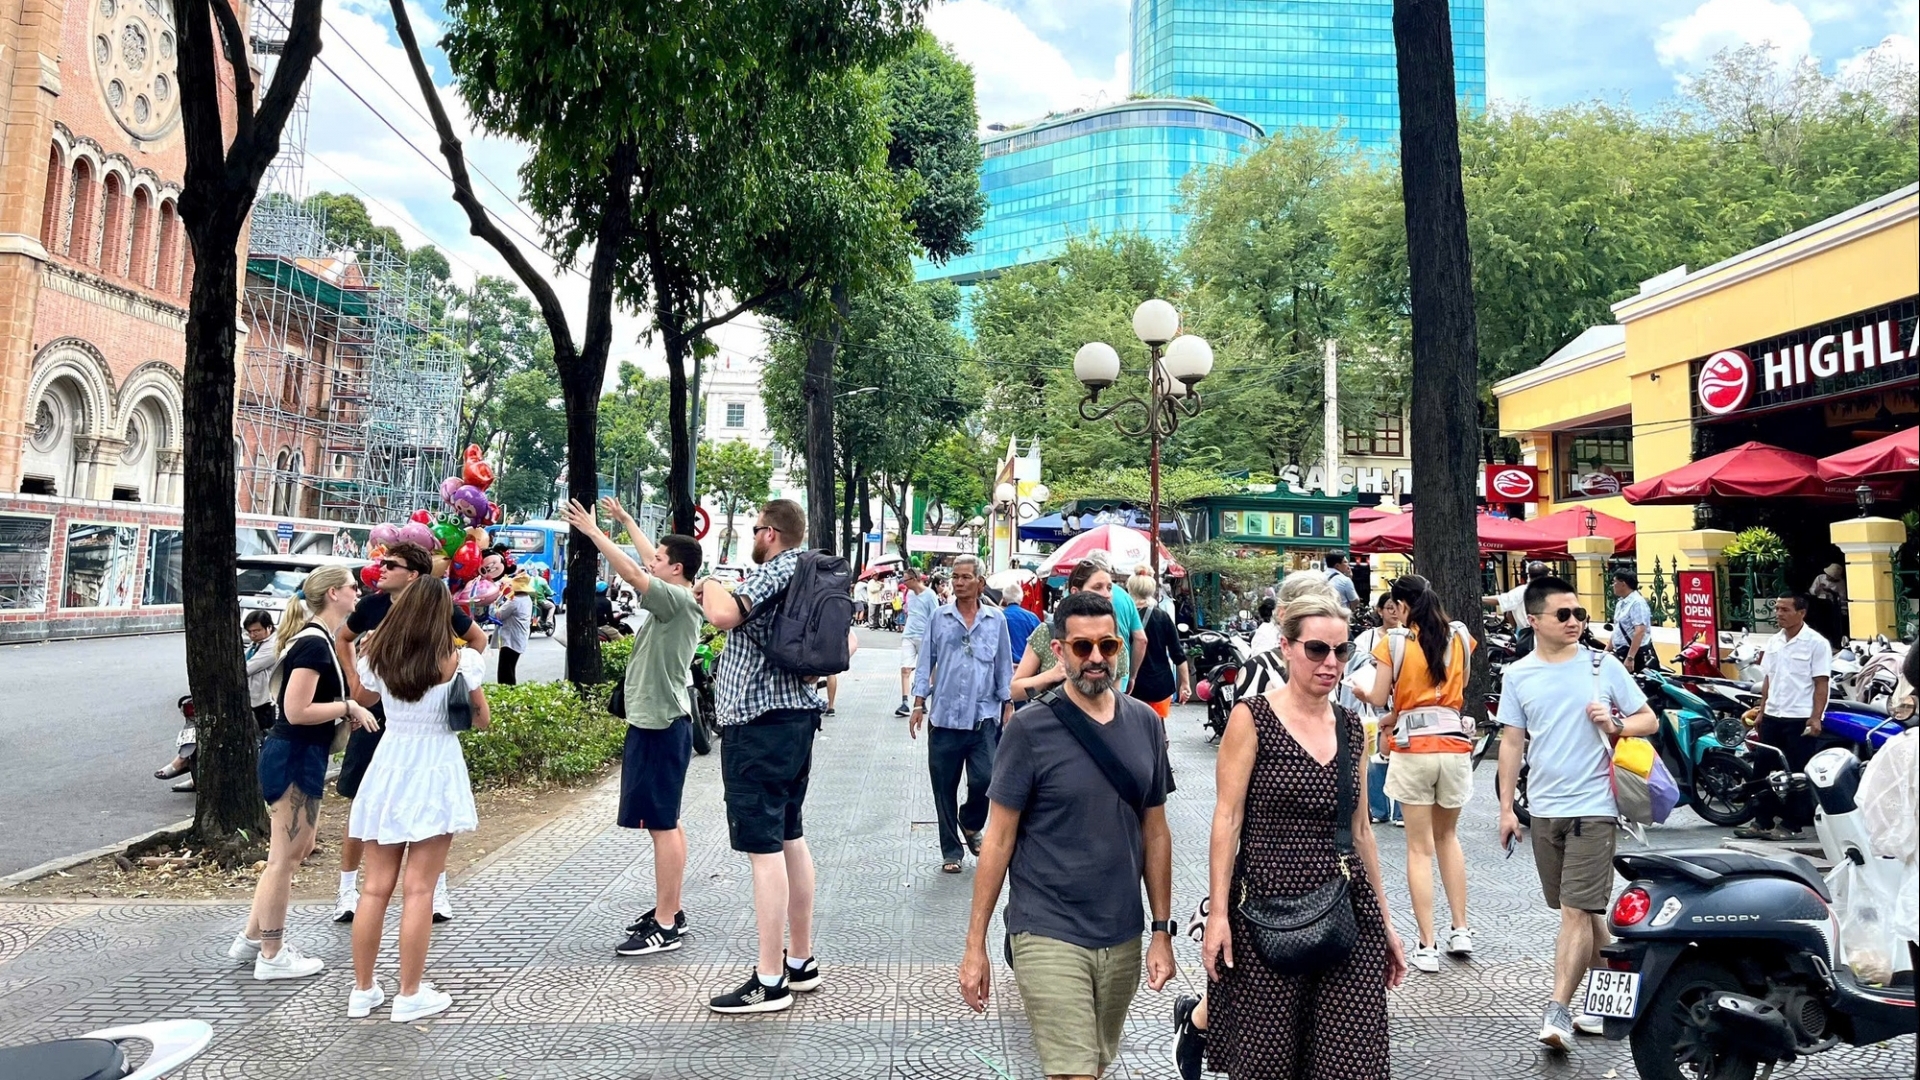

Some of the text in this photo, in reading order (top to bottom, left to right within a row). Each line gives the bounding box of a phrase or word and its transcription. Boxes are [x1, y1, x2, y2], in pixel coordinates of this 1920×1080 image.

[1684, 593, 1709, 605] NOW
[1684, 605, 1712, 617] OPEN
[1691, 914, 1760, 923] SCOOPY
[1596, 972, 1632, 994] 59-FA
[1589, 993, 1633, 1015] 098.42
